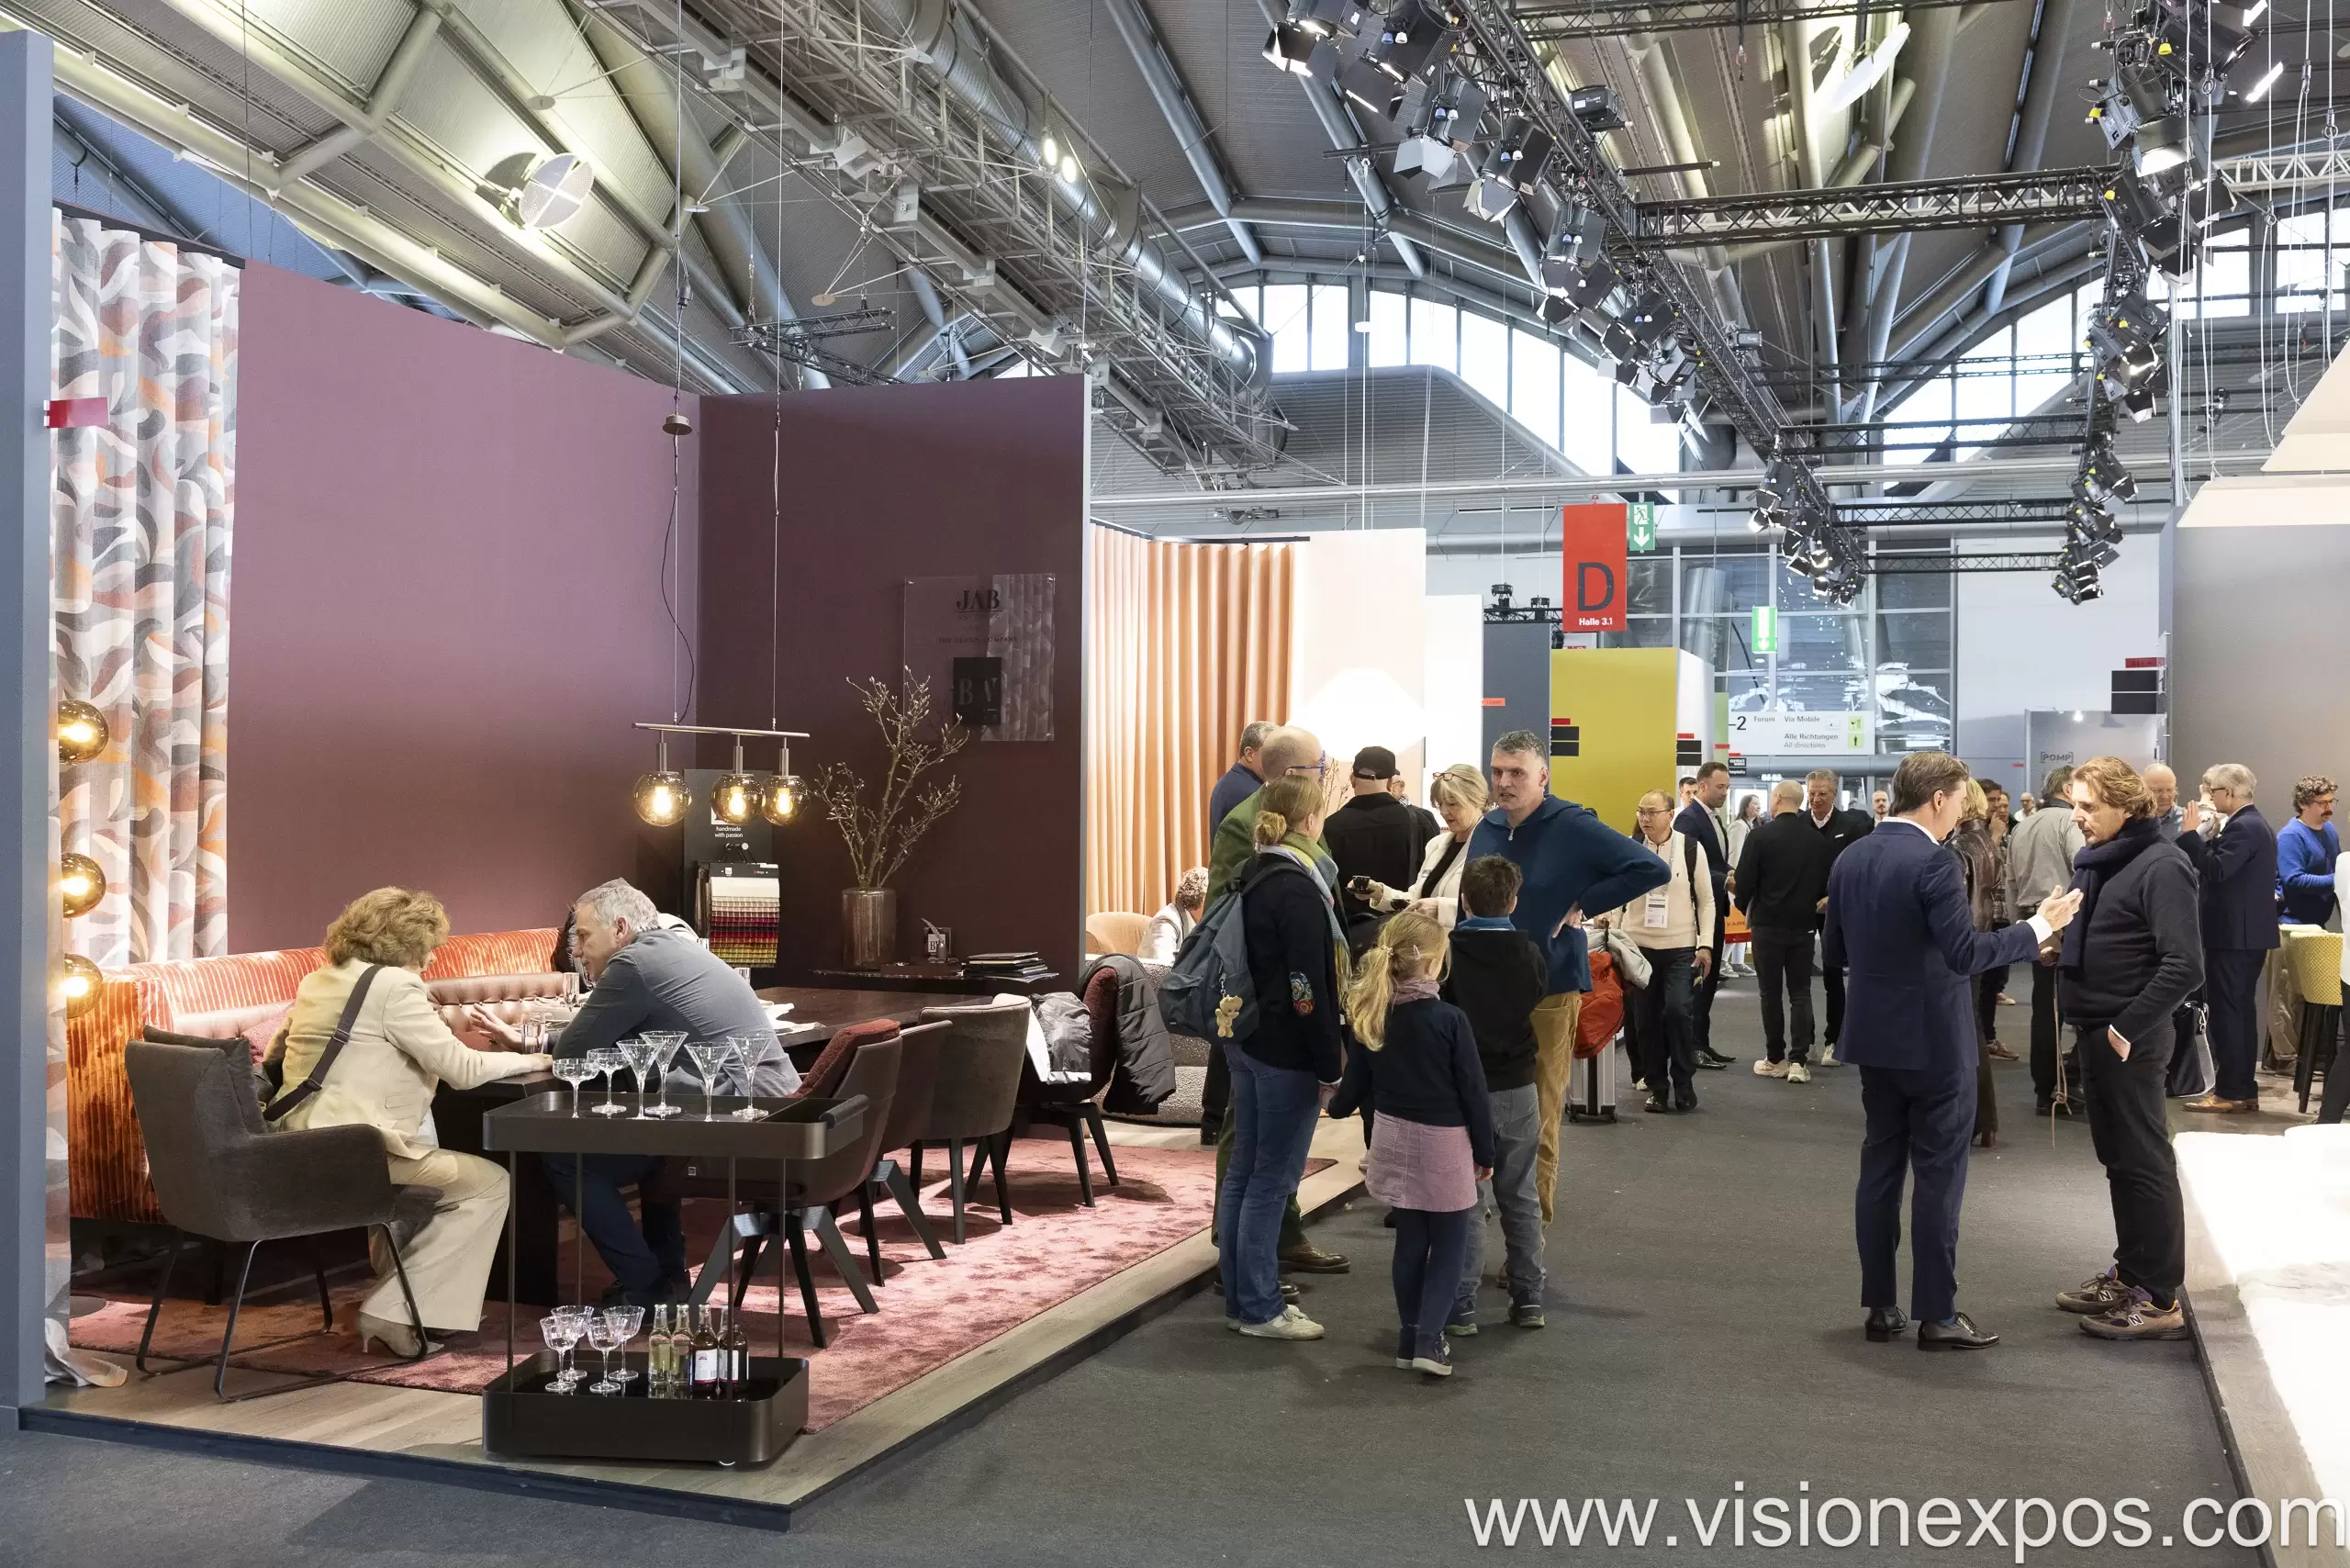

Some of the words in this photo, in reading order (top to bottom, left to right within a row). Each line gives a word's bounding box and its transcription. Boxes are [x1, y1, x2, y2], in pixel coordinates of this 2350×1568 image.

[1577, 562, 1615, 612] D
[956, 589, 1001, 610] JAB
[1579, 618, 1600, 626] Halle
[1601, 617, 1613, 626] 3.1
